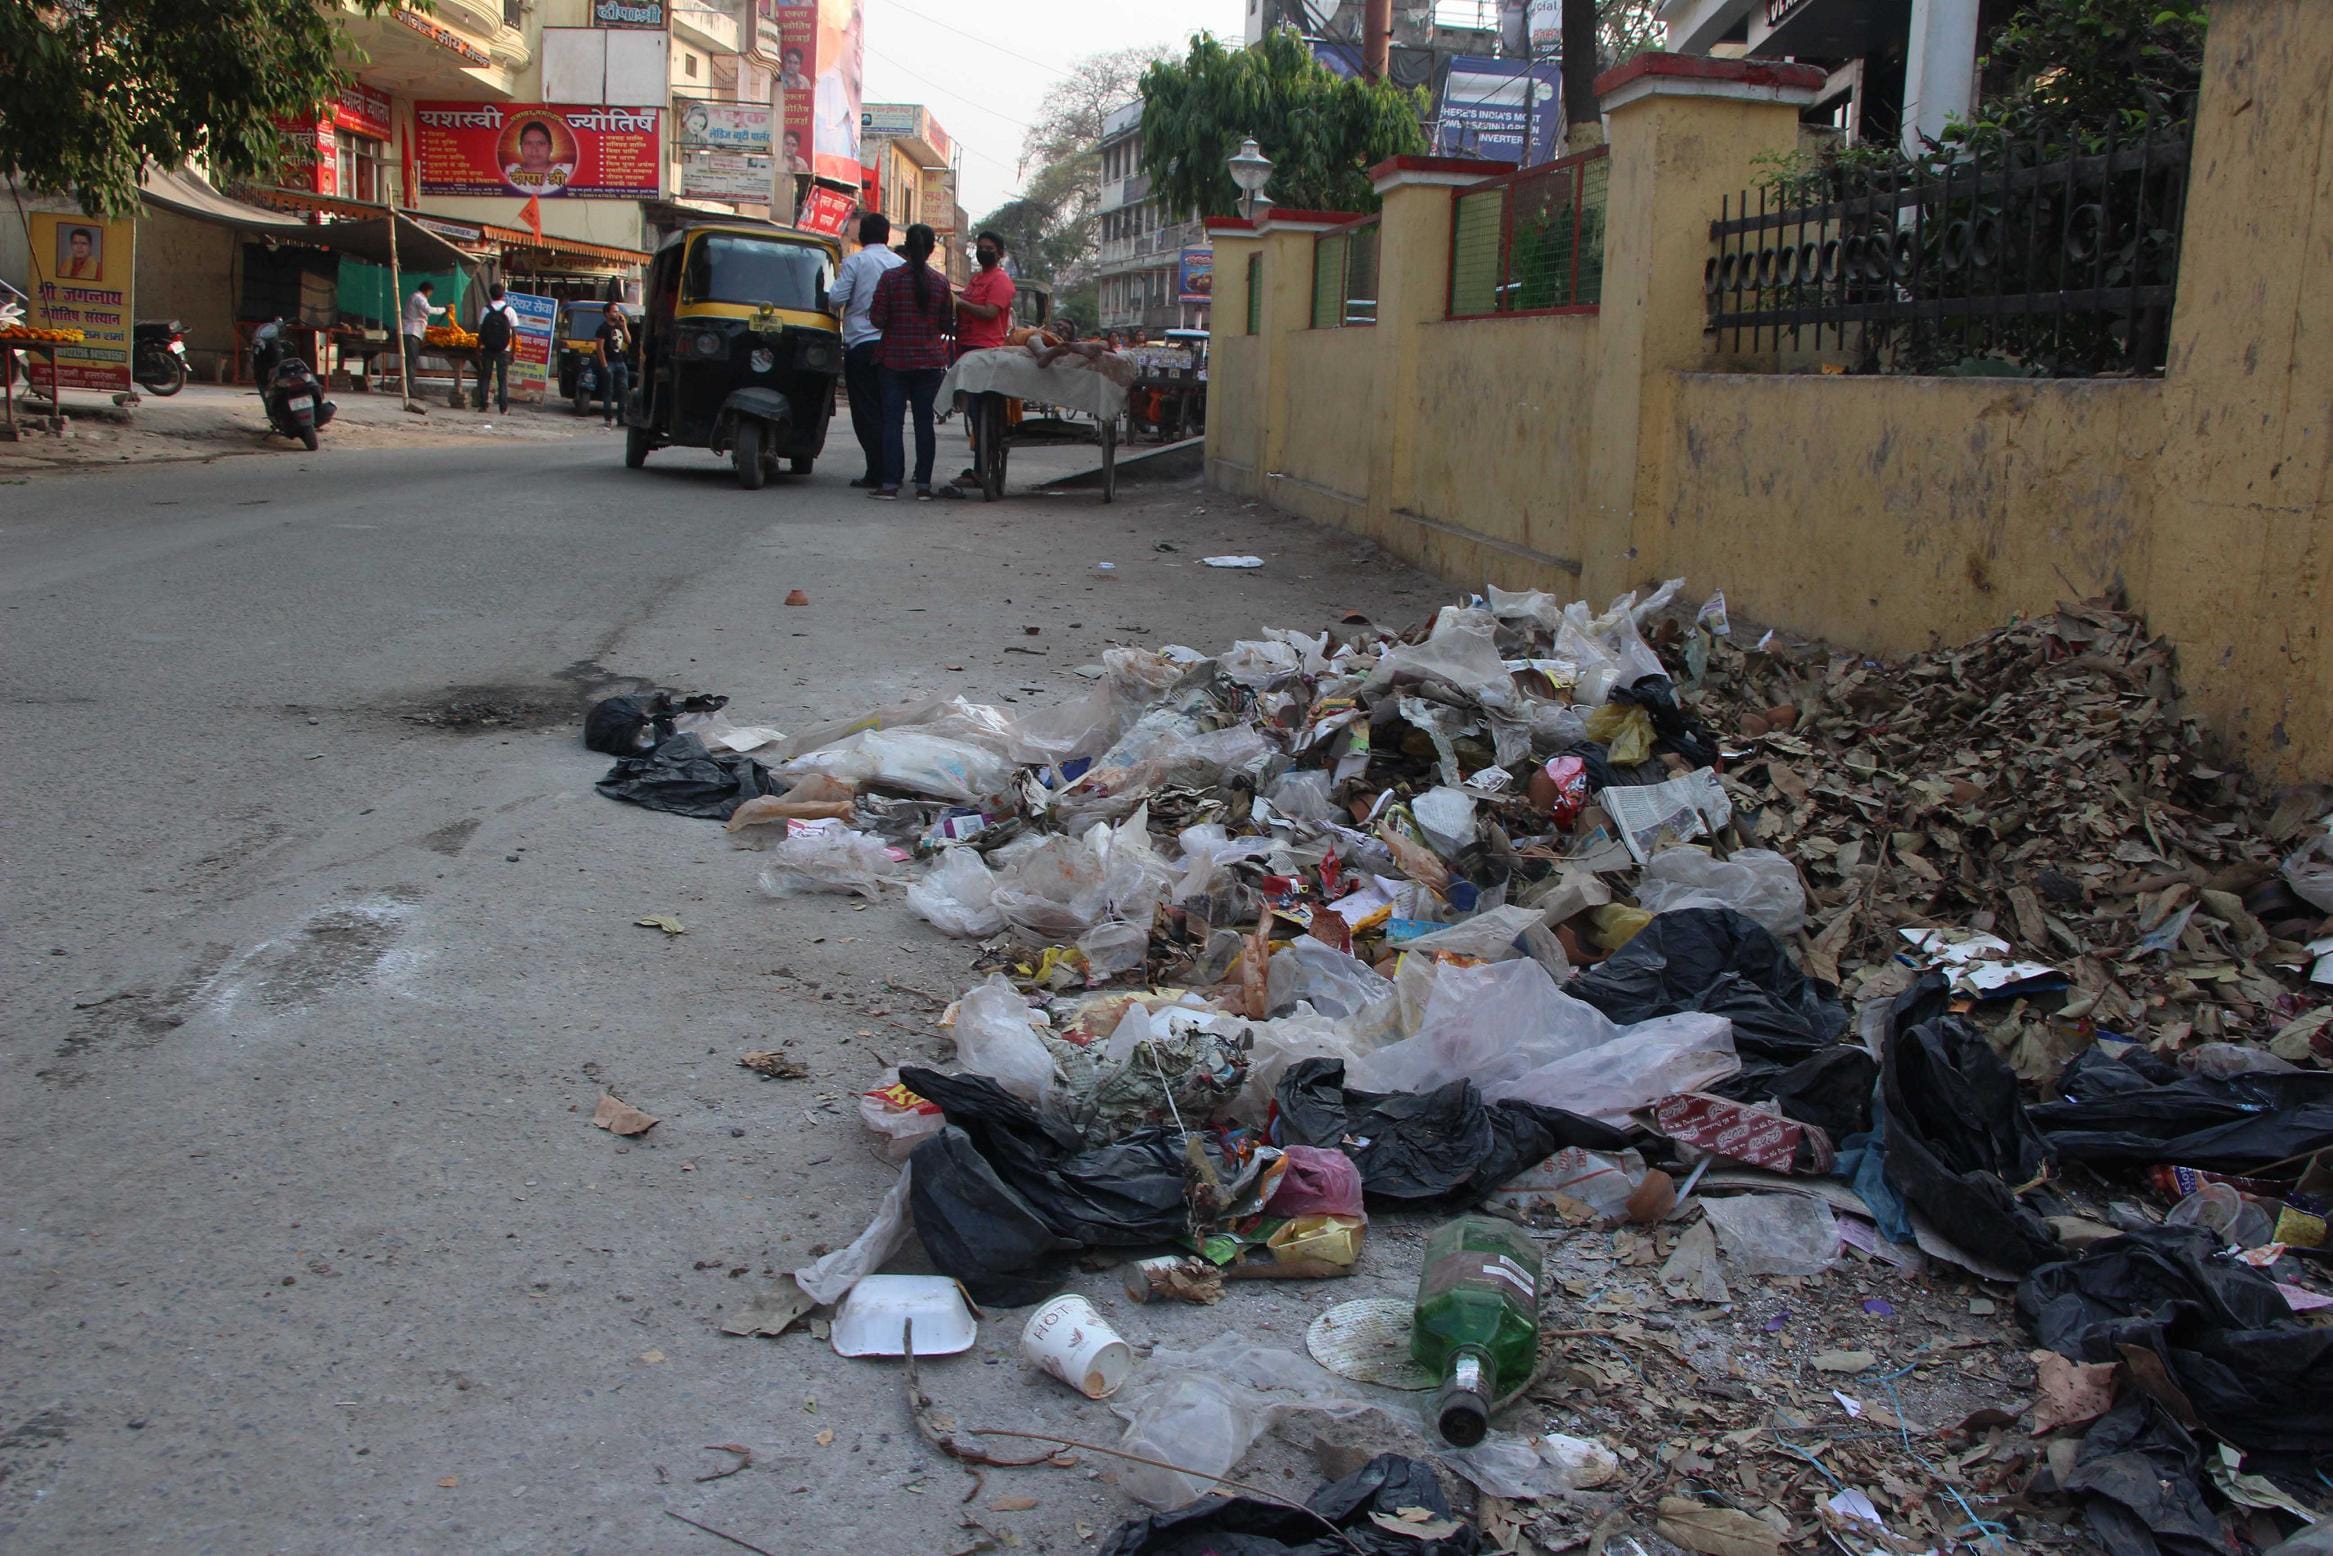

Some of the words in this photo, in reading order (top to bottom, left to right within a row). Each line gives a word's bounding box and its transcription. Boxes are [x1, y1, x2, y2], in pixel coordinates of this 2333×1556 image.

[419, 105, 504, 129] यशस्वी
[566, 108, 656, 132] ज्योतिष
[1443, 107, 1477, 118] HERE'S
[1479, 110, 1512, 121] INDIA'S
[1479, 133, 1523, 145] INVERTER
[509, 167, 545, 186] दीपा
[547, 168, 568, 186] श्री
[1033, 1303, 1072, 1341] HOT
